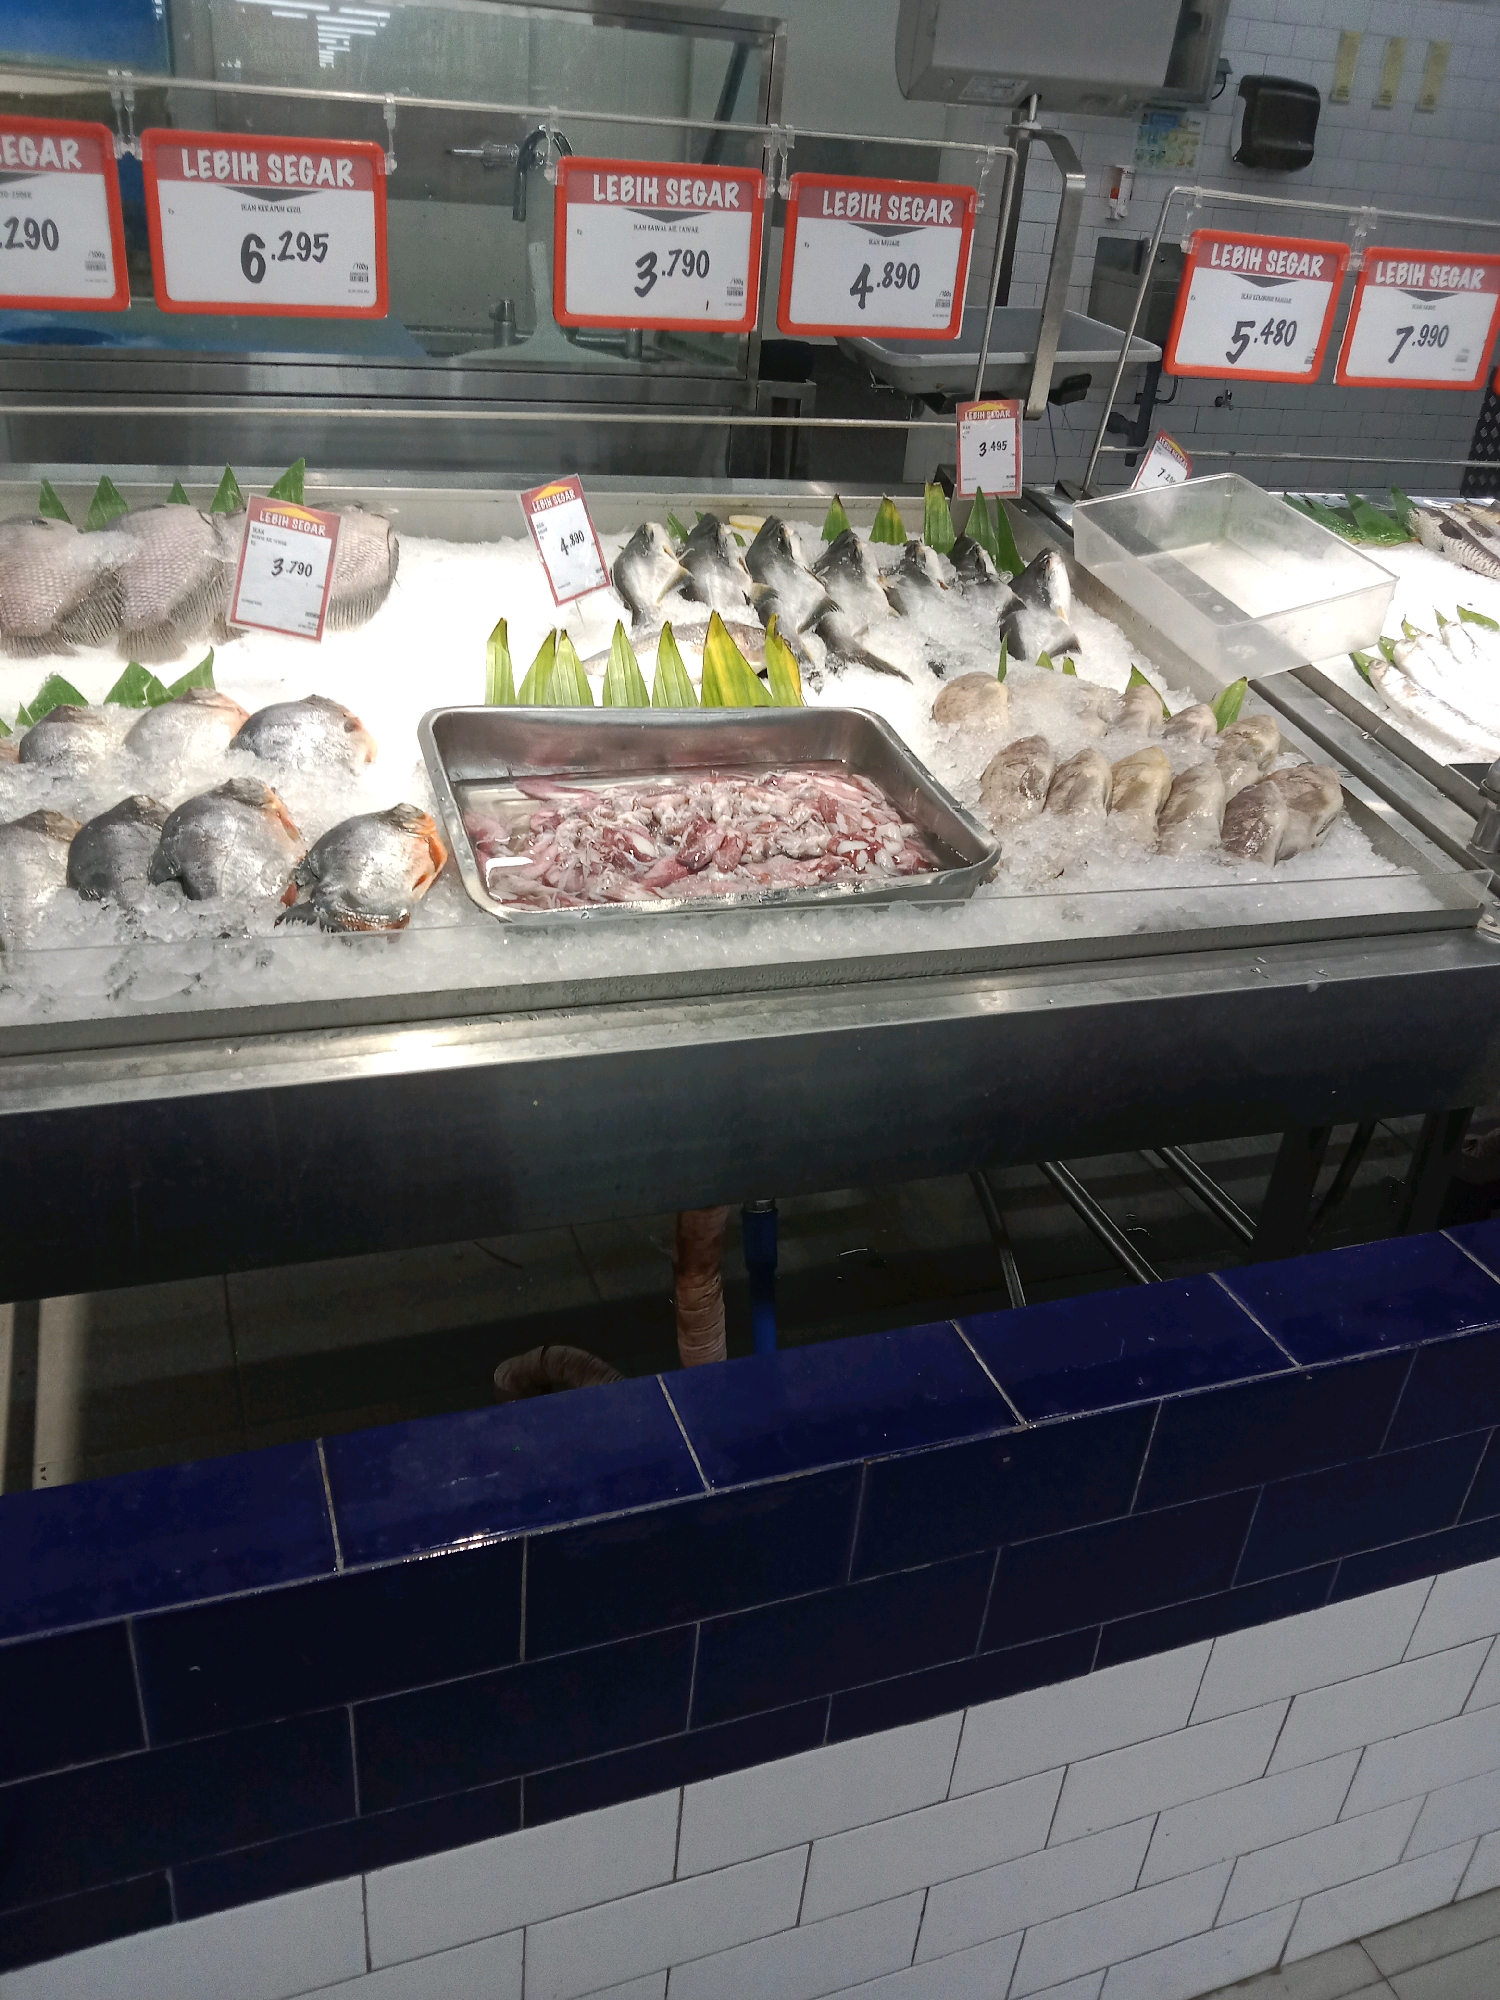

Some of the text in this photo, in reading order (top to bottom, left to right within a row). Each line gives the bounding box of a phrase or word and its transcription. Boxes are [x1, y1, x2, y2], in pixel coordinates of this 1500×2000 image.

[0, 135, 82, 169] EGAR
[181, 148, 355, 188] LEBIH SEGAR
[593, 174, 740, 209] LEBIH SEGAR
[822, 190, 954, 224] LEBIH SEGAR
[240, 230, 329, 284] 6.295
[634, 248, 710, 298] 3.790
[1210, 243, 1325, 277] LEBIH SEGAR
[849, 261, 921, 310] 4.890
[1375, 261, 1485, 290] LEBIH SEGAR
[1225, 318, 1298, 365] 5.480
[1387, 324, 1450, 364] 7.990
[964, 409, 1010, 420] LEBIH SEGAR
[978, 440, 1008, 457] 3.495
[531, 488, 576, 513] LEBIH SEGAR
[259, 510, 326, 536] LEBIH SEGAR
[560, 530, 585, 556] 4.890
[271, 557, 314, 578] 3.790
